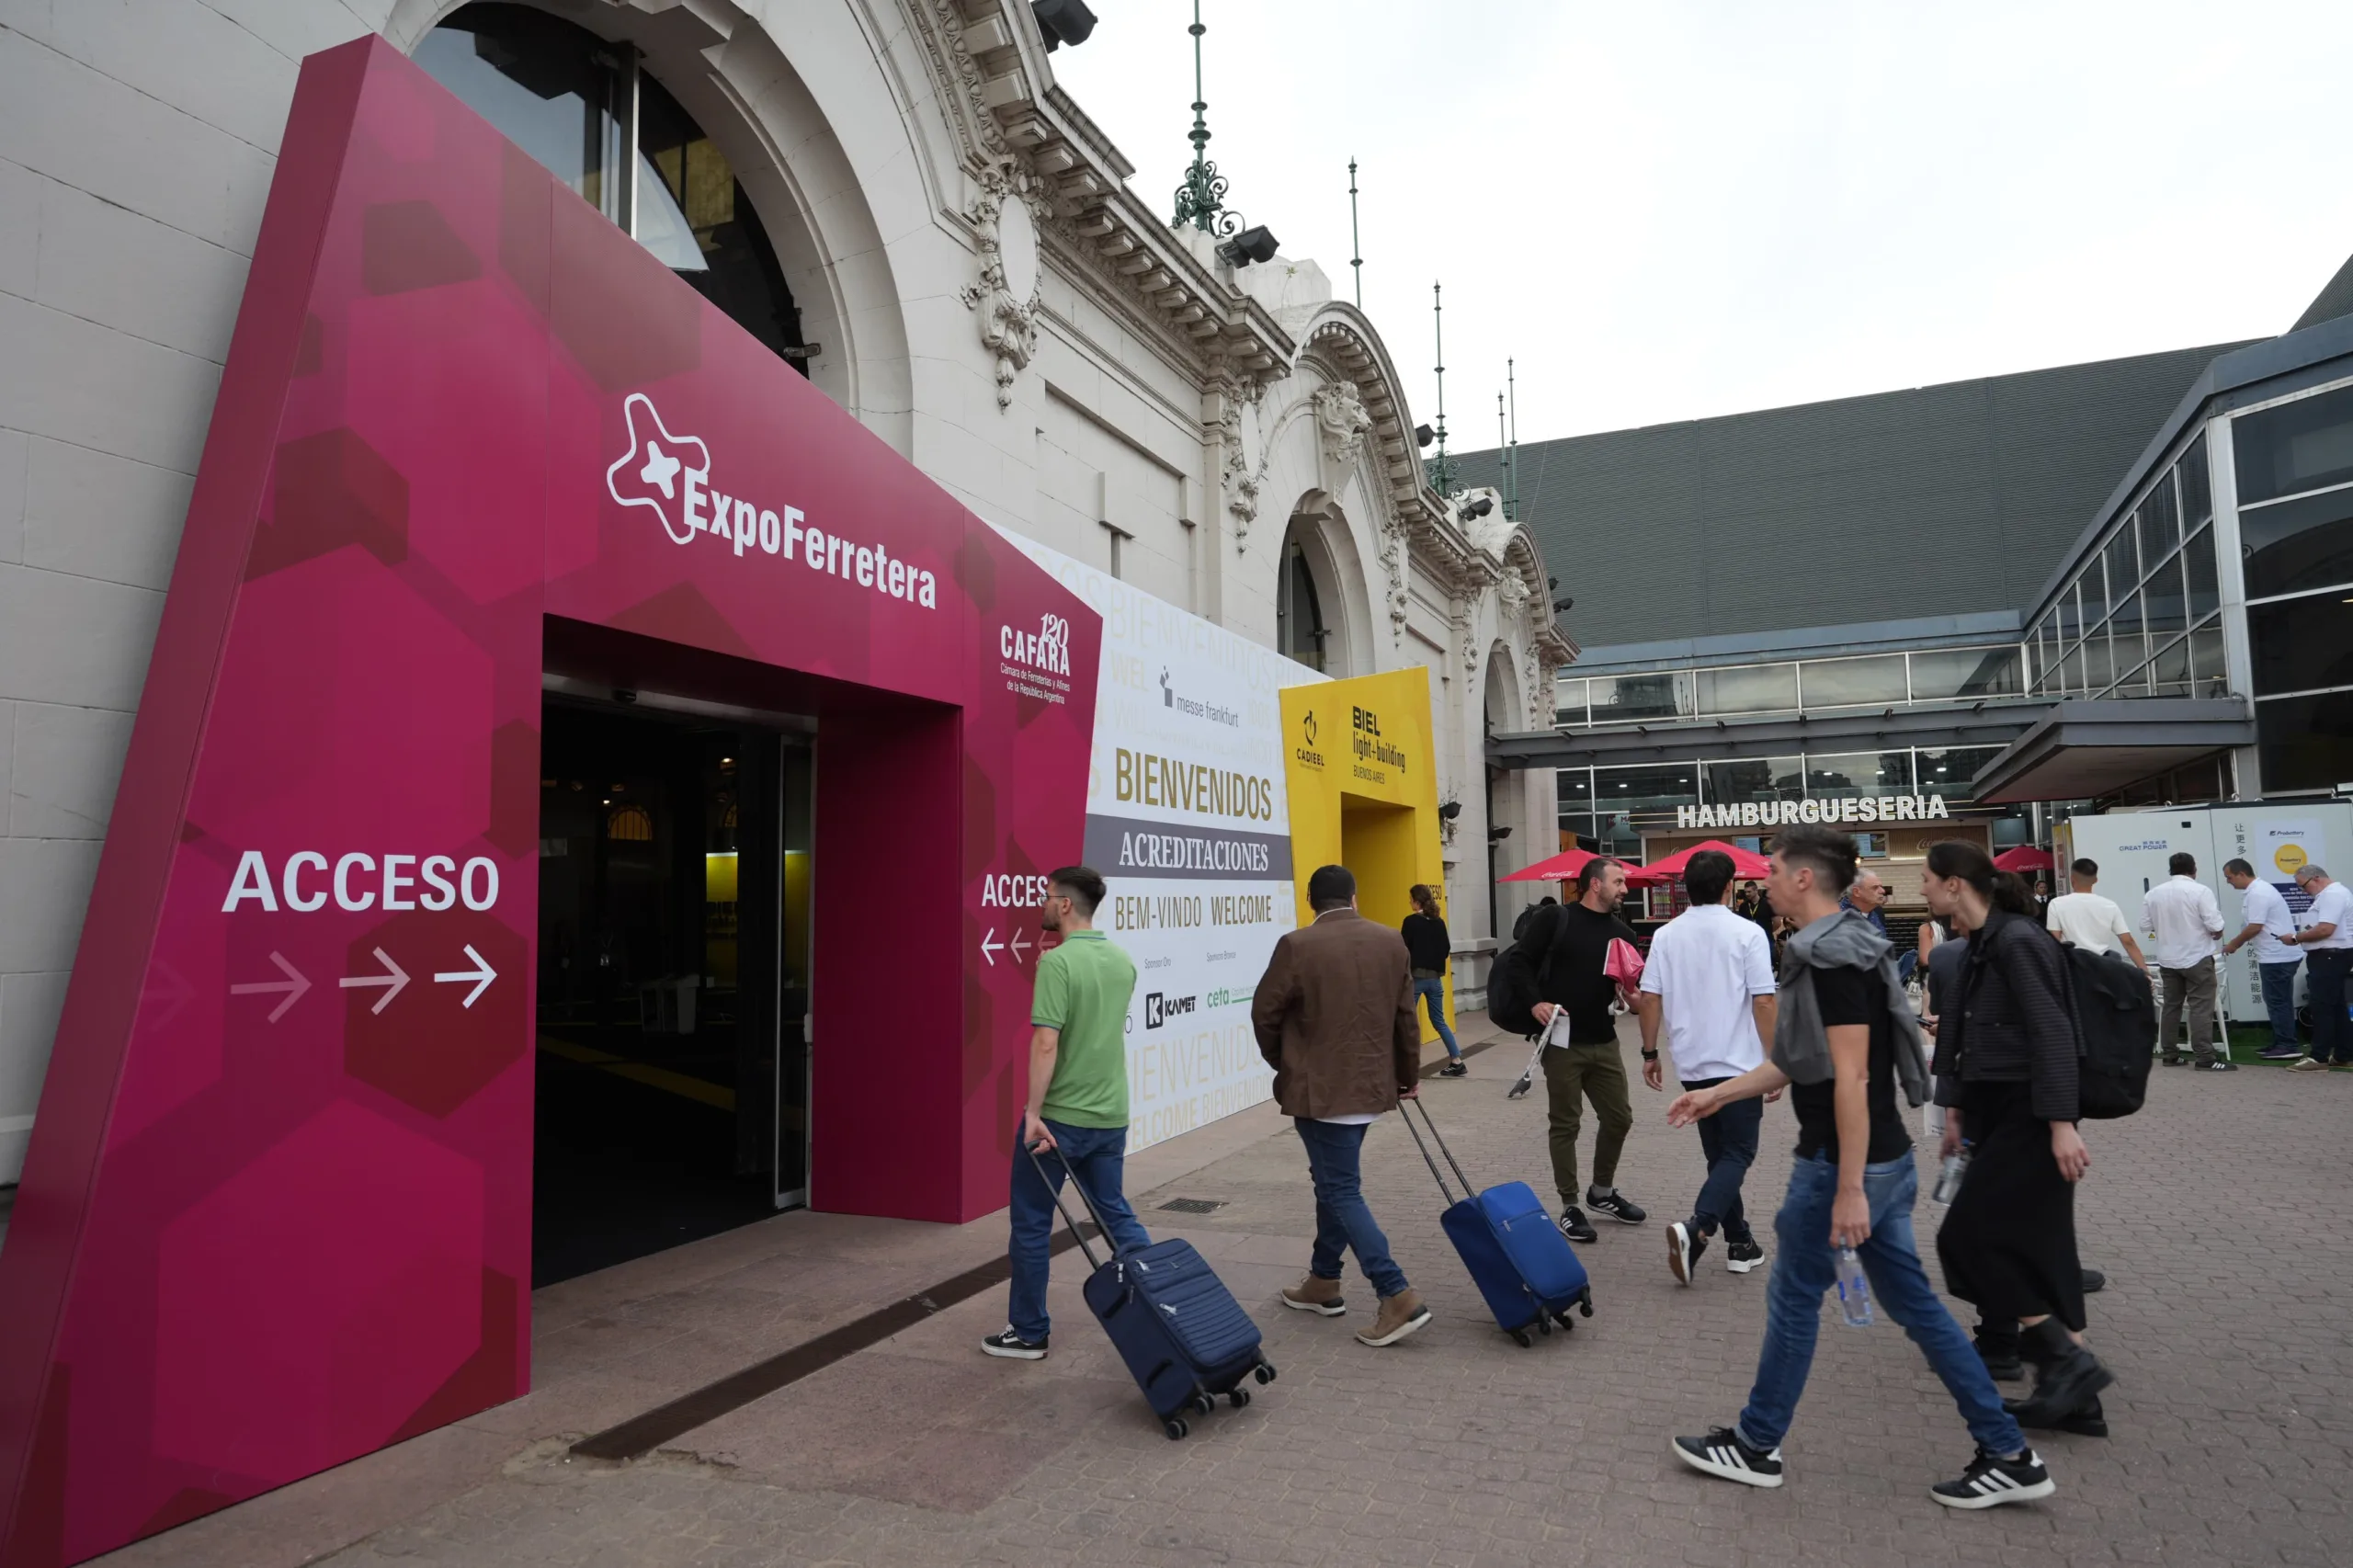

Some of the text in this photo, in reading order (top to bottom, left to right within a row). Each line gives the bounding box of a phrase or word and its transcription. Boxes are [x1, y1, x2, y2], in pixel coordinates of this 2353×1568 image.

[684, 465, 937, 610] ExpoFerretera
[1040, 612, 1069, 649] 120
[1000, 625, 1071, 677] CAFARA
[1000, 662, 1020, 679] Cámara
[1020, 669, 1028, 680] de
[1056, 678, 1071, 692] Afines
[1006, 680, 1065, 705] de la República Argentina
[1176, 696, 1204, 718] messe
[1206, 701, 1239, 728] frankfurt
[1353, 705, 1381, 737] BIEL
[1296, 747, 1325, 767] CADIEEL
[1116, 746, 1272, 822] BIENVENIDOS
[1353, 764, 1385, 785] BUENOS AIRES
[1677, 793, 1949, 828] HAMBURGUESERIA
[1119, 831, 1269, 872] ACREDITACIONES
[2143, 843, 2168, 851] POWER
[221, 850, 500, 913] ACCESO
[981, 873, 1049, 908] ACCES
[1115, 894, 1202, 931] BEM-VINDO
[1211, 894, 1273, 926] WELCOME
[1144, 957, 1172, 970] Sponsor Oro
[1165, 995, 1197, 1017] KAMET
[1207, 987, 1230, 1009] ceta
[1133, 1023, 1263, 1106] IENVENID
